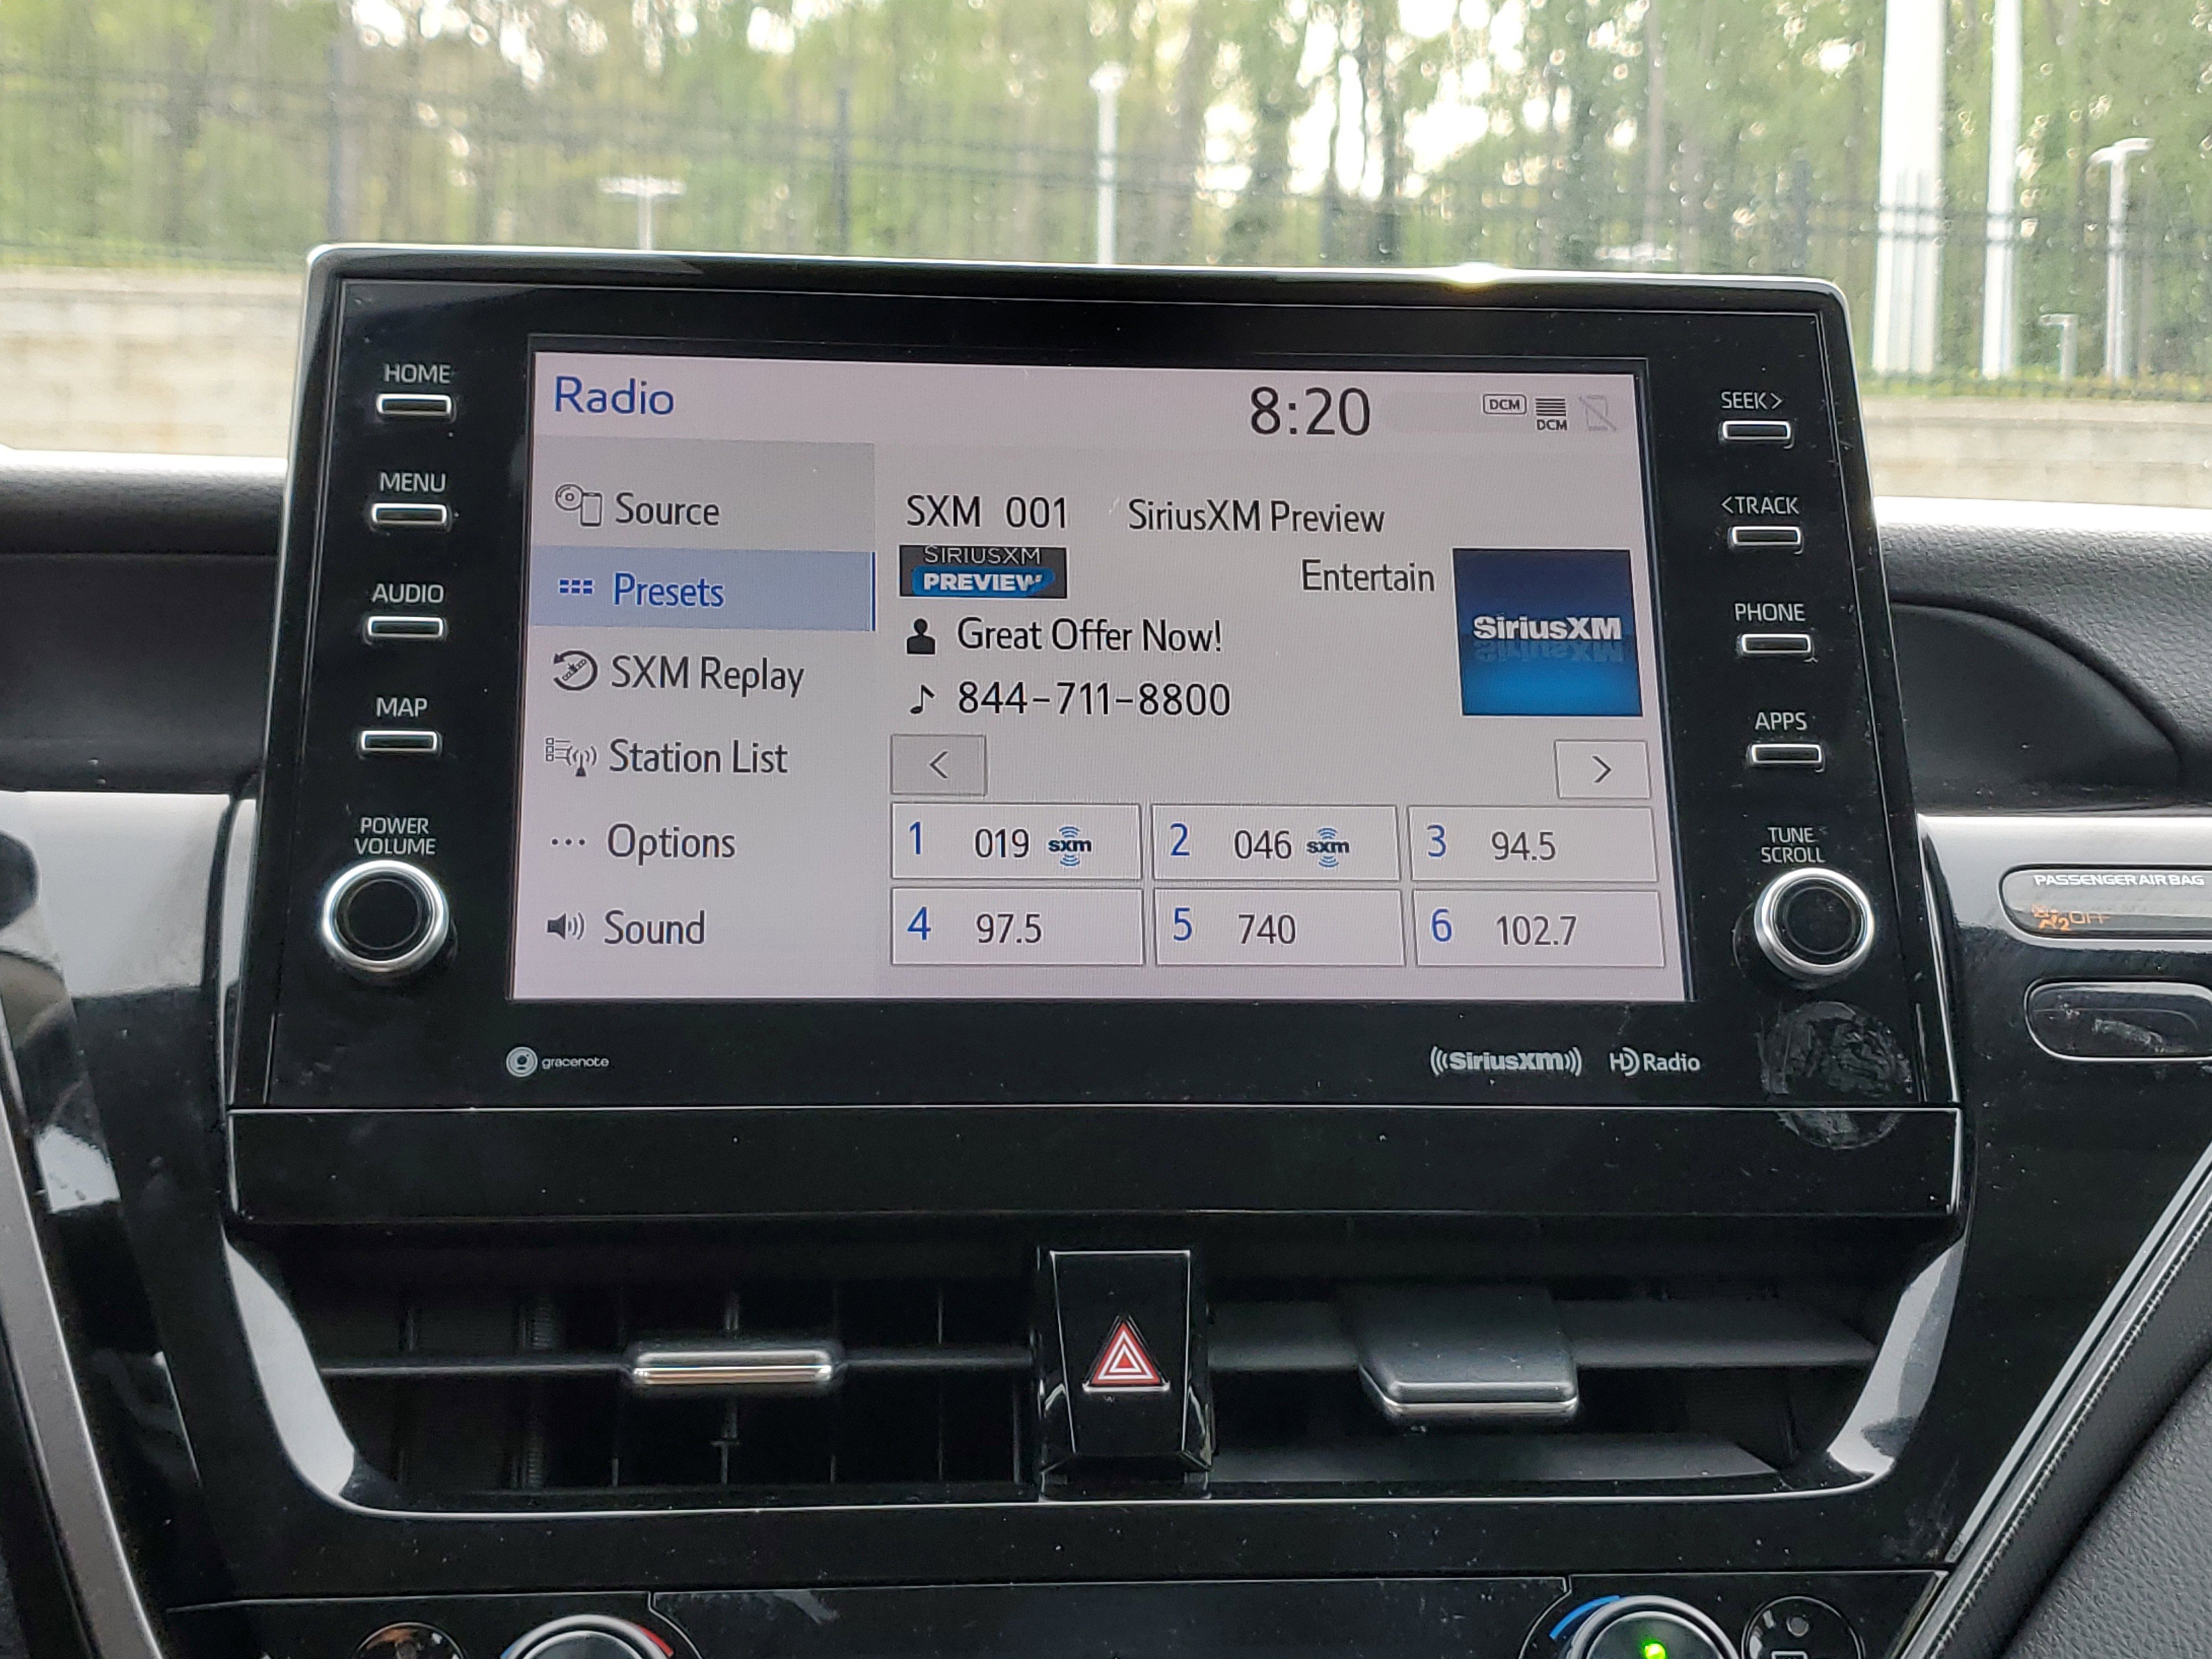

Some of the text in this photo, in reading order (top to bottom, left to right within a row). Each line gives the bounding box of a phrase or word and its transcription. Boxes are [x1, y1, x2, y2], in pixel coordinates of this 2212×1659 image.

[383, 363, 452, 383] HOME
[554, 375, 675, 415] Radio
[1249, 386, 1371, 436] 8:20
[1489, 399, 1520, 410] DCM
[1536, 419, 1568, 431] DCM
[379, 473, 447, 492] MENU
[615, 492, 720, 526] Source
[906, 495, 1065, 528] SXM 001
[1128, 499, 1384, 532] SiriusXM Preview
[924, 546, 1040, 565] SIRIUSXM
[614, 572, 725, 607] Presets
[1302, 560, 1435, 591] Entertain
[372, 584, 444, 603] AUDIO
[1473, 615, 1622, 640] SiriusXM
[1734, 603, 1805, 621] PHONE
[958, 617, 1222, 652] Great Offer Now!
[611, 656, 805, 698] SXM Replay
[376, 697, 427, 716] MAP
[958, 681, 1231, 715] 844-711-8800
[1755, 712, 1807, 730] APPS
[609, 738, 788, 773] Station List
[360, 817, 428, 834] POWER
[909, 822, 922, 854] 1
[974, 828, 1030, 857] 019
[1170, 823, 1191, 856] 2
[1234, 830, 1292, 859] 046
[1768, 827, 1813, 843] TUNE
[354, 838, 437, 855] VOLUME
[607, 823, 736, 866] Options
[1426, 825, 1556, 861] 3 94.5
[1761, 847, 1826, 862] SCROLL
[2034, 874, 2137, 885] PASSENGER
[603, 910, 706, 944] Sound
[907, 906, 1043, 944] 4 97.5
[1173, 907, 1296, 945] 5 740
[1431, 909, 1577, 946] 6 102.7
[541, 1057, 609, 1069] gracenote
[1644, 1052, 1700, 1071] Radio
